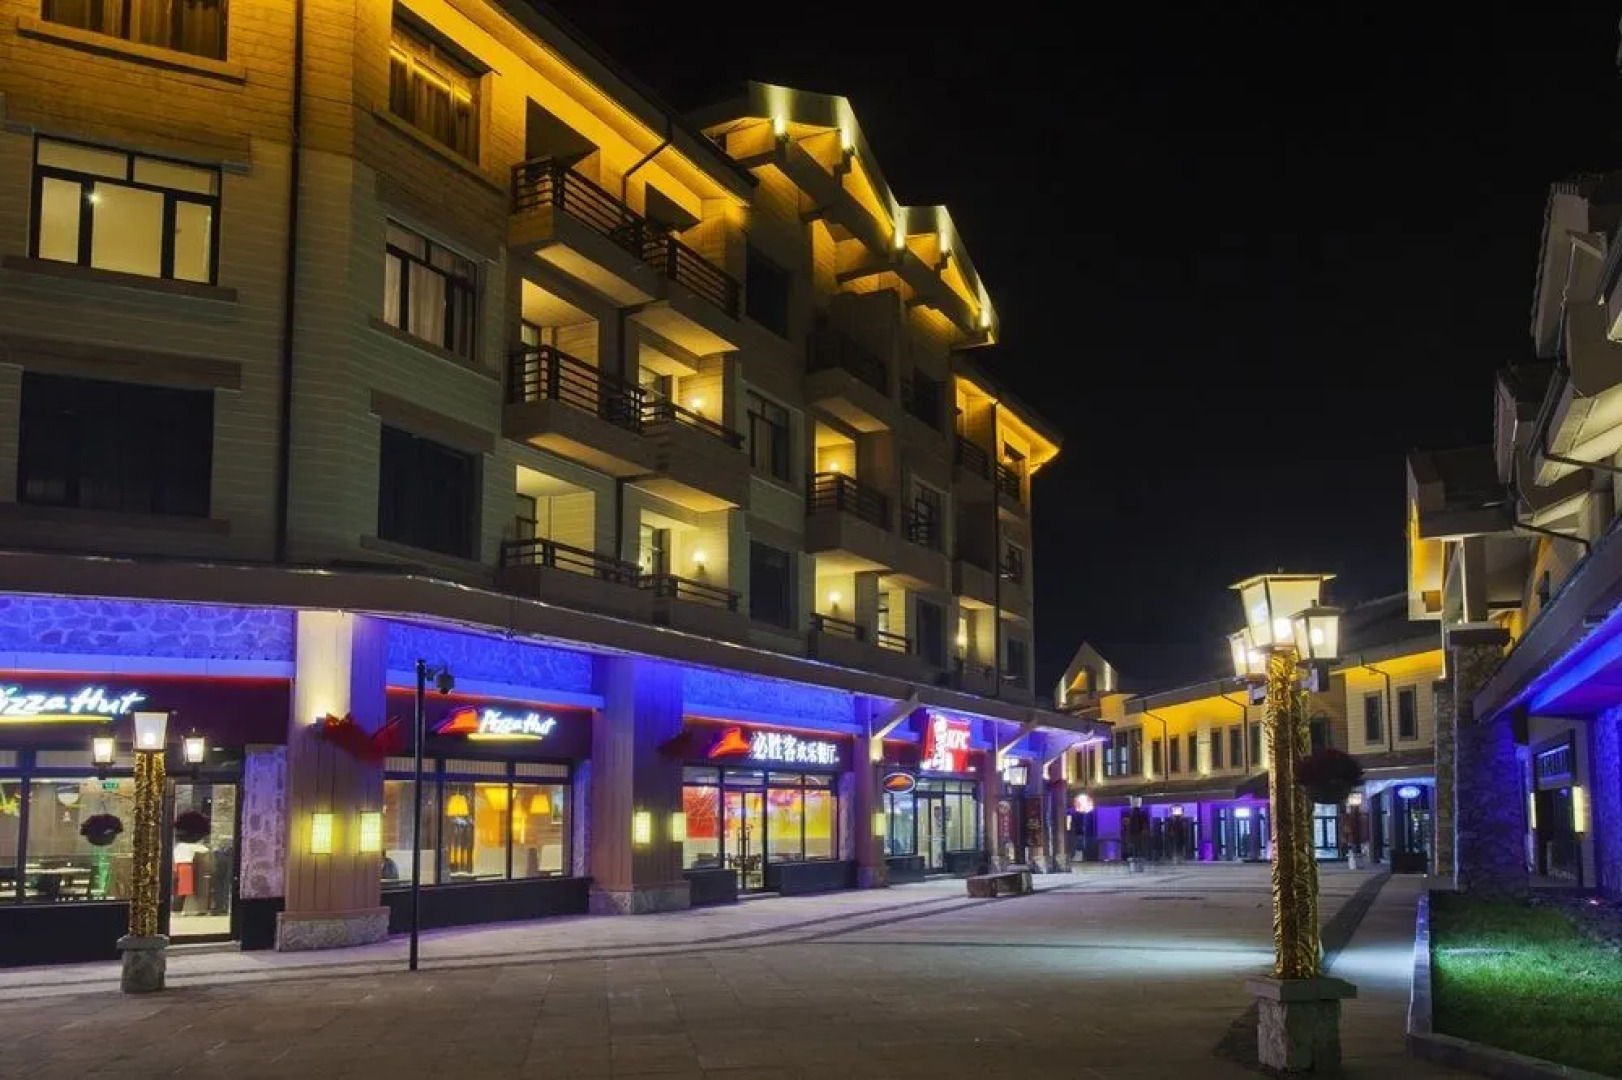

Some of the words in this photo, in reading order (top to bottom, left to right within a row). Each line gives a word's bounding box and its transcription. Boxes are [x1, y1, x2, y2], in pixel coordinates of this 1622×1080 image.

[70, 686, 146, 714] Hut
[480, 709, 522, 733] Pizza
[523, 713, 556, 734] Hut
[947, 730, 970, 749] KFC
